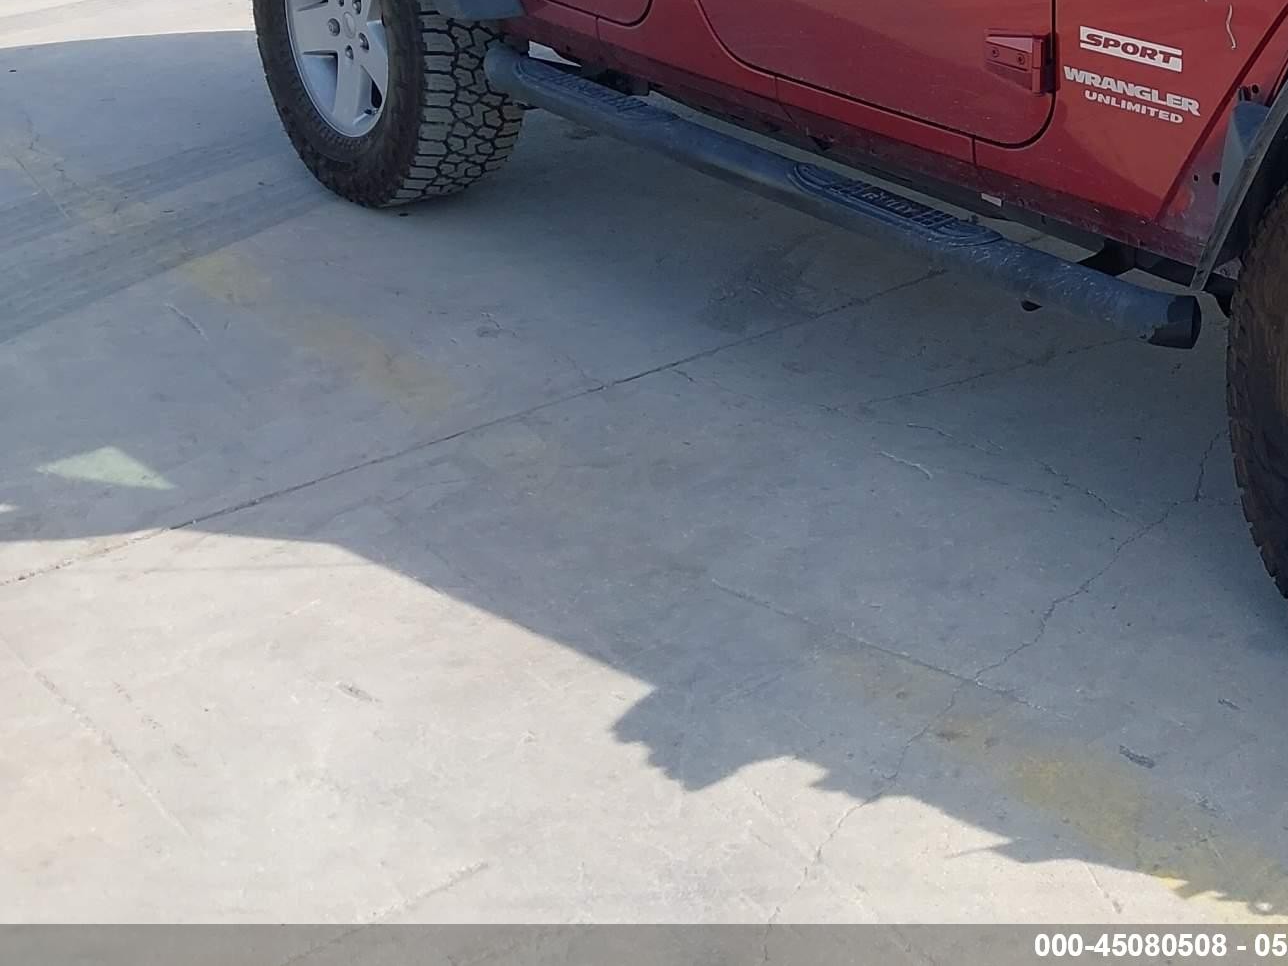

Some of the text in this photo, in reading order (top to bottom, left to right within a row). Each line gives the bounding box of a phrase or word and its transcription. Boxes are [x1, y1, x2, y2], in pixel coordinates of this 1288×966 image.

[1080, 31, 1182, 67] SPORT
[1063, 65, 1201, 116] WRANGLER
[1084, 89, 1184, 124] UNLIMITED
